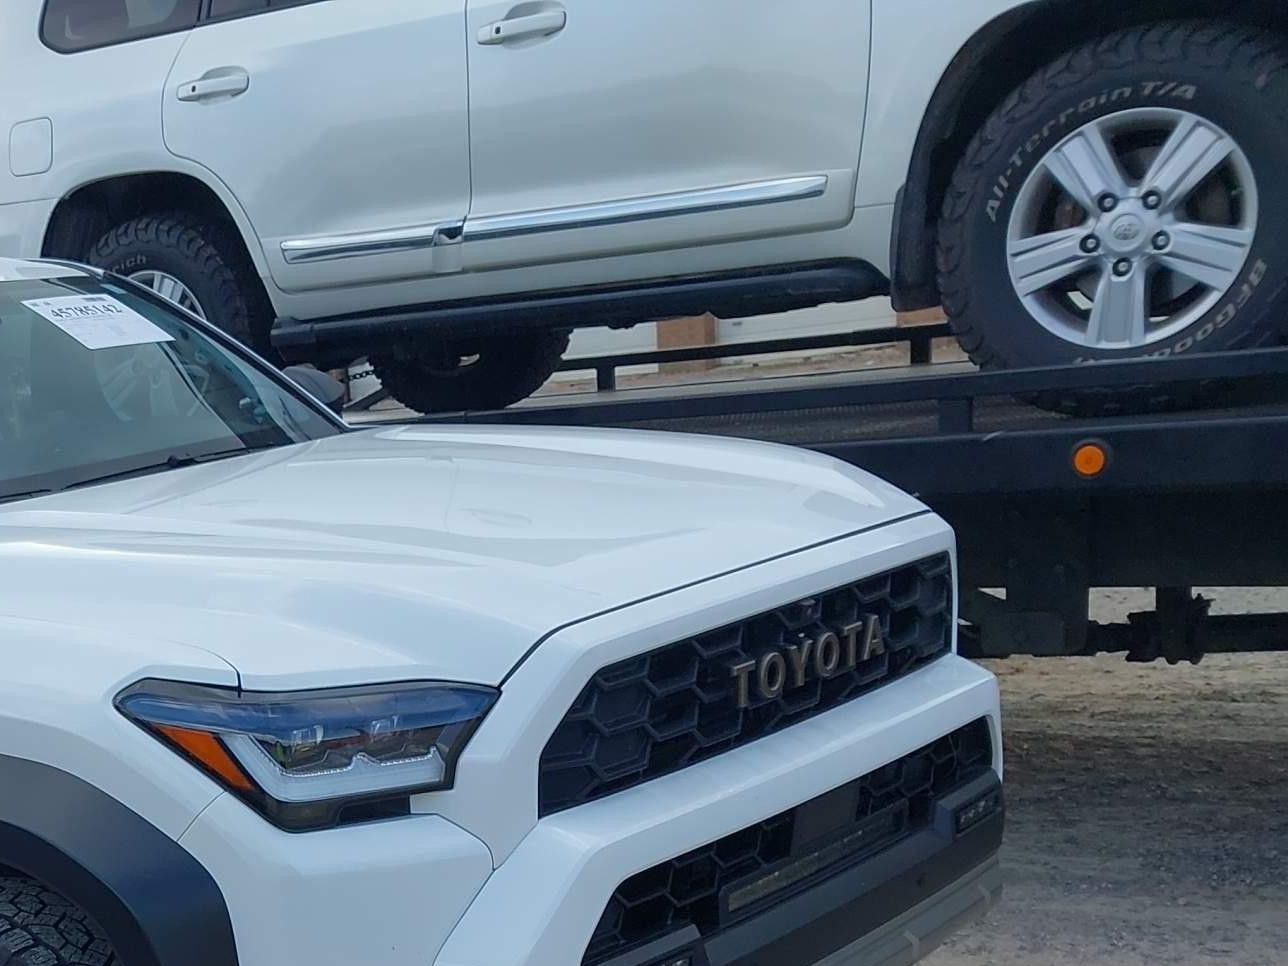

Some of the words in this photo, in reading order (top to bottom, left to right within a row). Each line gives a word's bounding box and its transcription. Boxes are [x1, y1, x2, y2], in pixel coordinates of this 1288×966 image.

[986, 86, 1132, 223] All-Terrain
[1141, 81, 1198, 100] T/A
[50, 303, 123, 318] 45785142
[731, 613, 886, 708] TOYOTA
